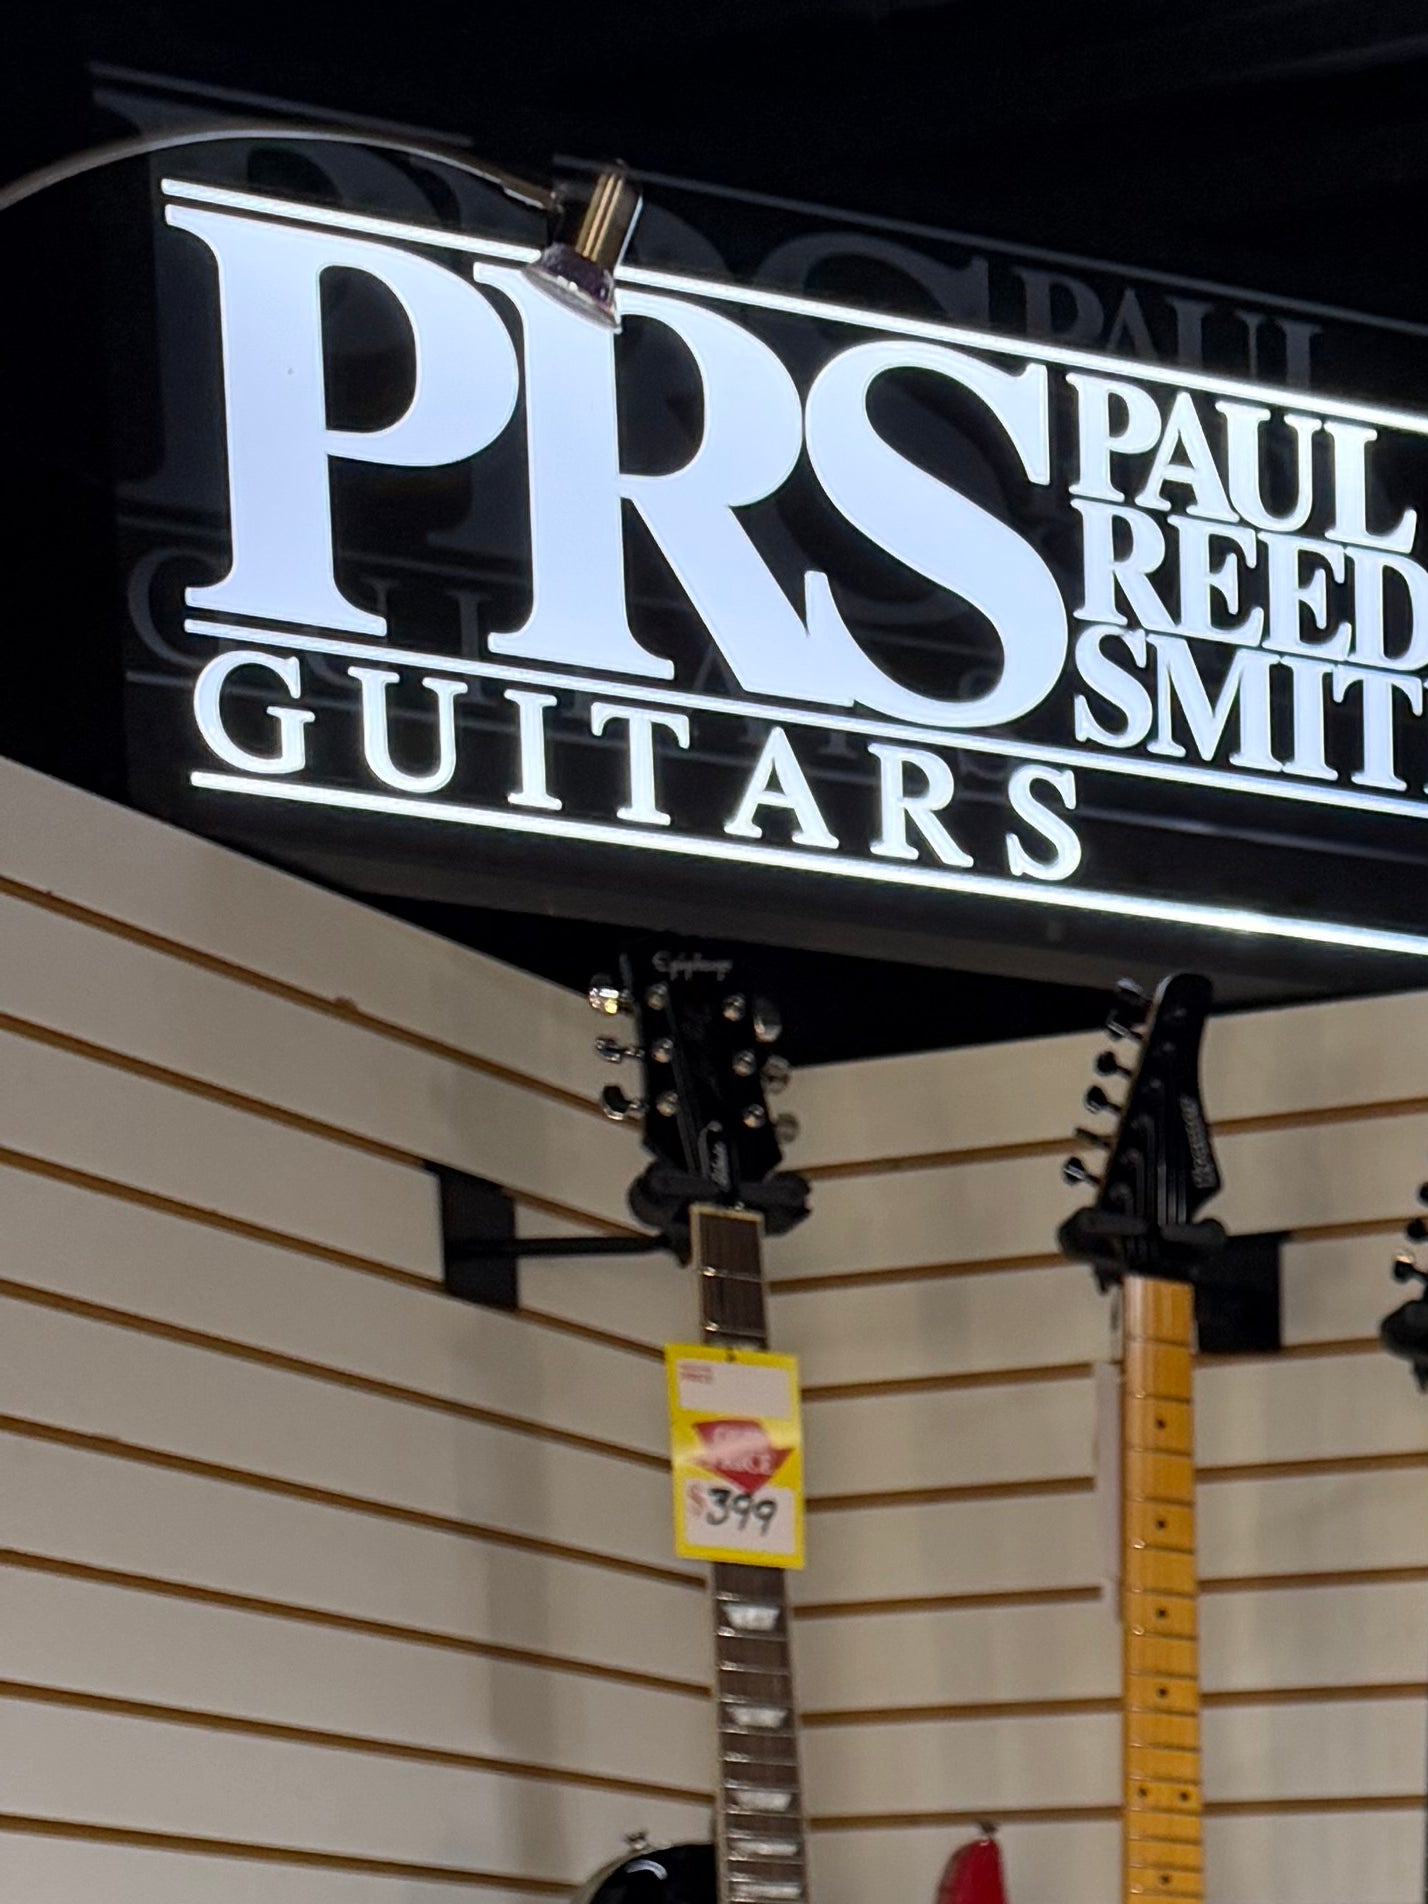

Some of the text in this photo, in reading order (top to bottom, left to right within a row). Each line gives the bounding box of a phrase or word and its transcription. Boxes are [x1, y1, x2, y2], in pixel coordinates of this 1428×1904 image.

[165, 203, 1070, 732] PRS
[1066, 369, 1419, 556] PAUL
[192, 650, 1085, 884] GUITARS
[686, 1484, 777, 1537] $399
